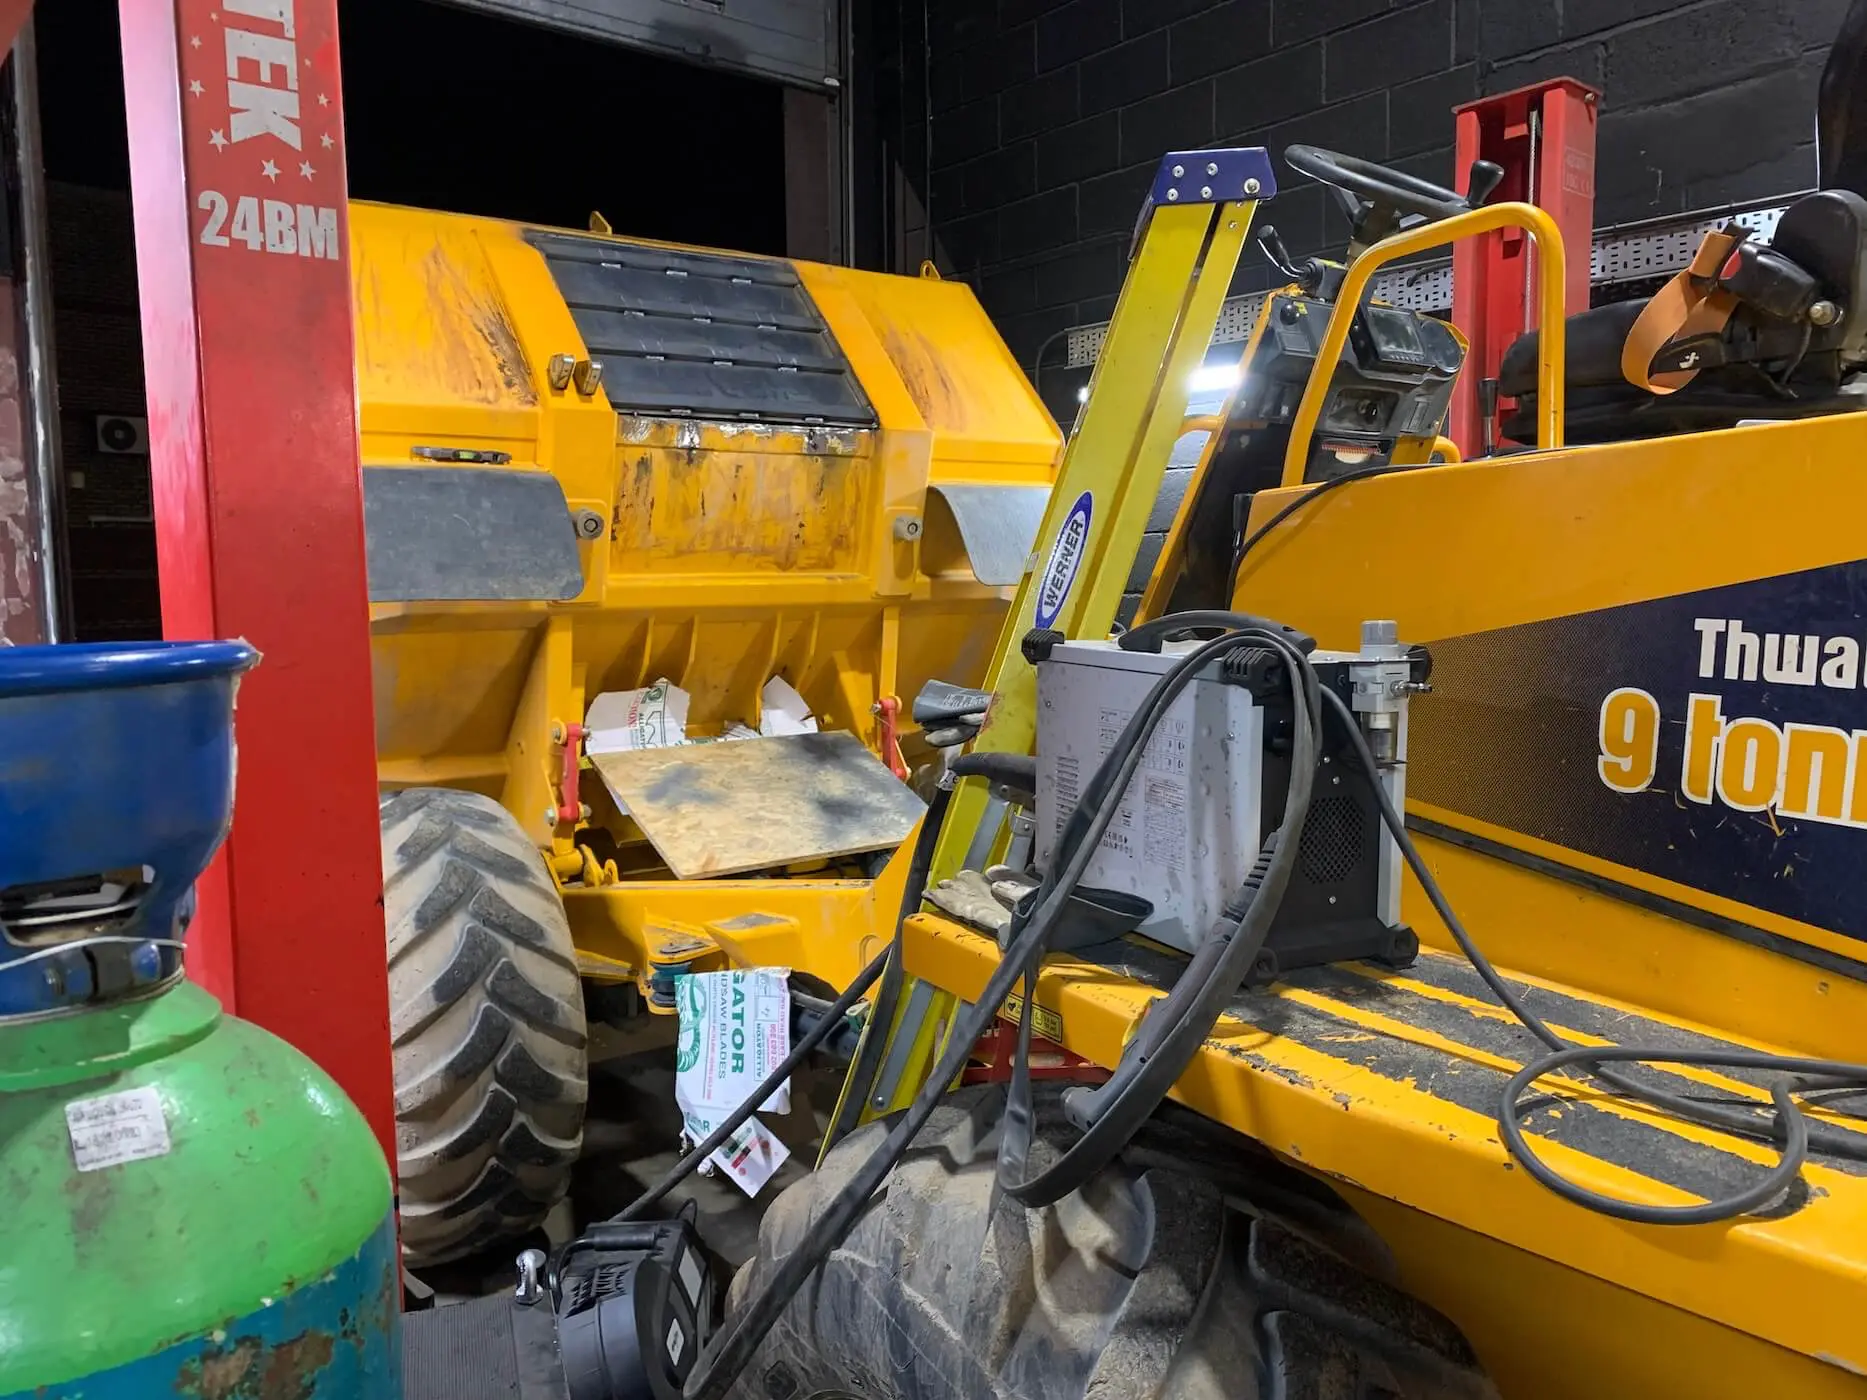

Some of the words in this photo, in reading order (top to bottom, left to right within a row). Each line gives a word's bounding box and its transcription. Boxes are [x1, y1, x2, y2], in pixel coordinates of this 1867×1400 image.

[198, 190, 338, 260] 24BM
[1044, 519, 1083, 608] WERNER
[1694, 618, 1867, 689] Thwa
[1598, 687, 1660, 793] 9
[1681, 693, 1867, 830] ton
[718, 1023, 728, 1080] BLADES
